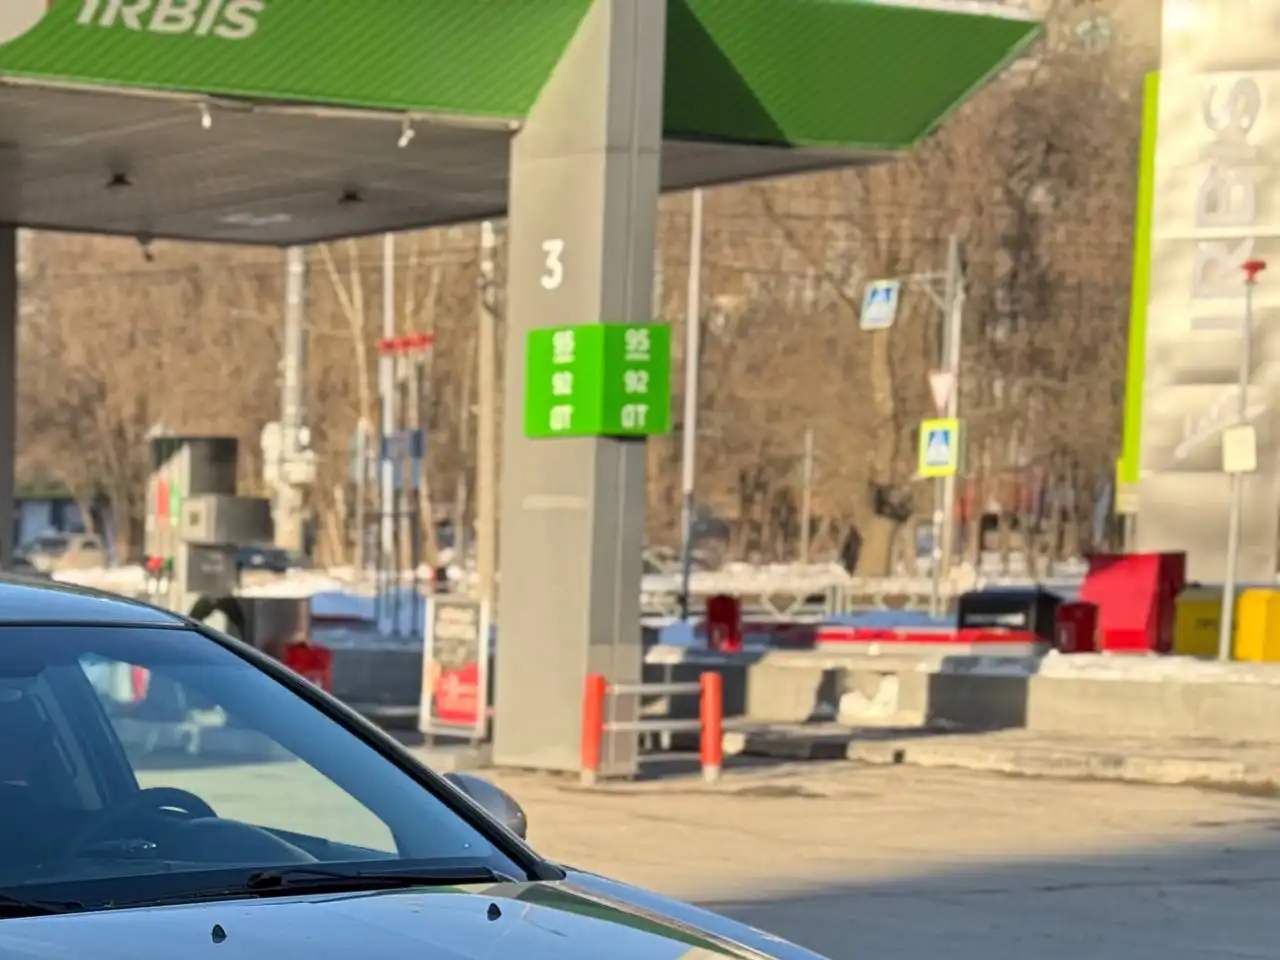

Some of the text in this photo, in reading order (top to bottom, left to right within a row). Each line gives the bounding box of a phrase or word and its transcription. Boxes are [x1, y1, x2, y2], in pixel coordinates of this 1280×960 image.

[76, 0, 266, 39] IRBIS
[540, 238, 565, 289] 3
[624, 328, 650, 354] 95
[623, 370, 650, 394] 92
